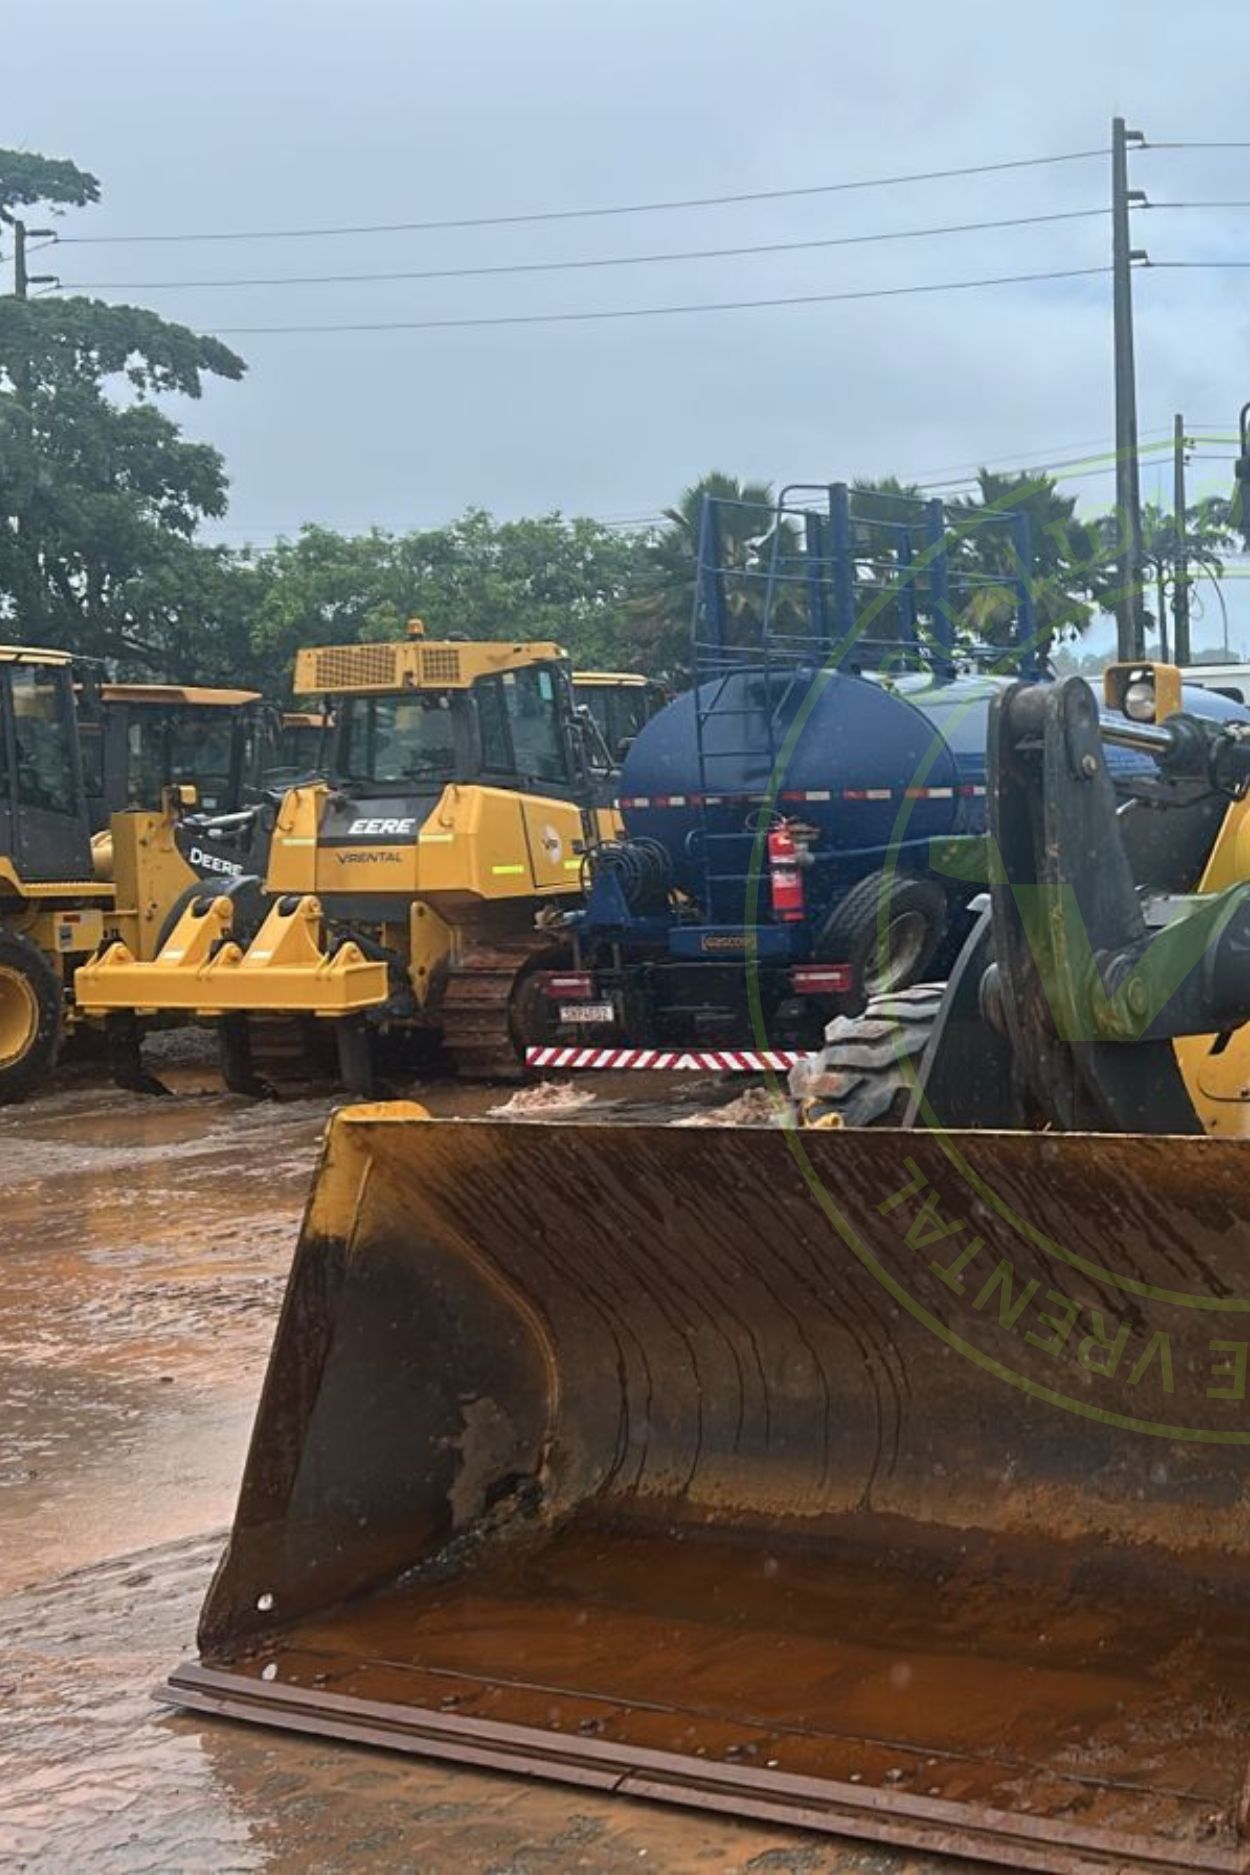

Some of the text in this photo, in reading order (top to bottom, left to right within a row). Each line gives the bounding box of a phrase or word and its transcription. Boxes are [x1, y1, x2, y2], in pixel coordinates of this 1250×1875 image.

[349, 818, 416, 835] EERE
[190, 847, 243, 876] DEERE
[336, 851, 404, 865] VRENTAL
